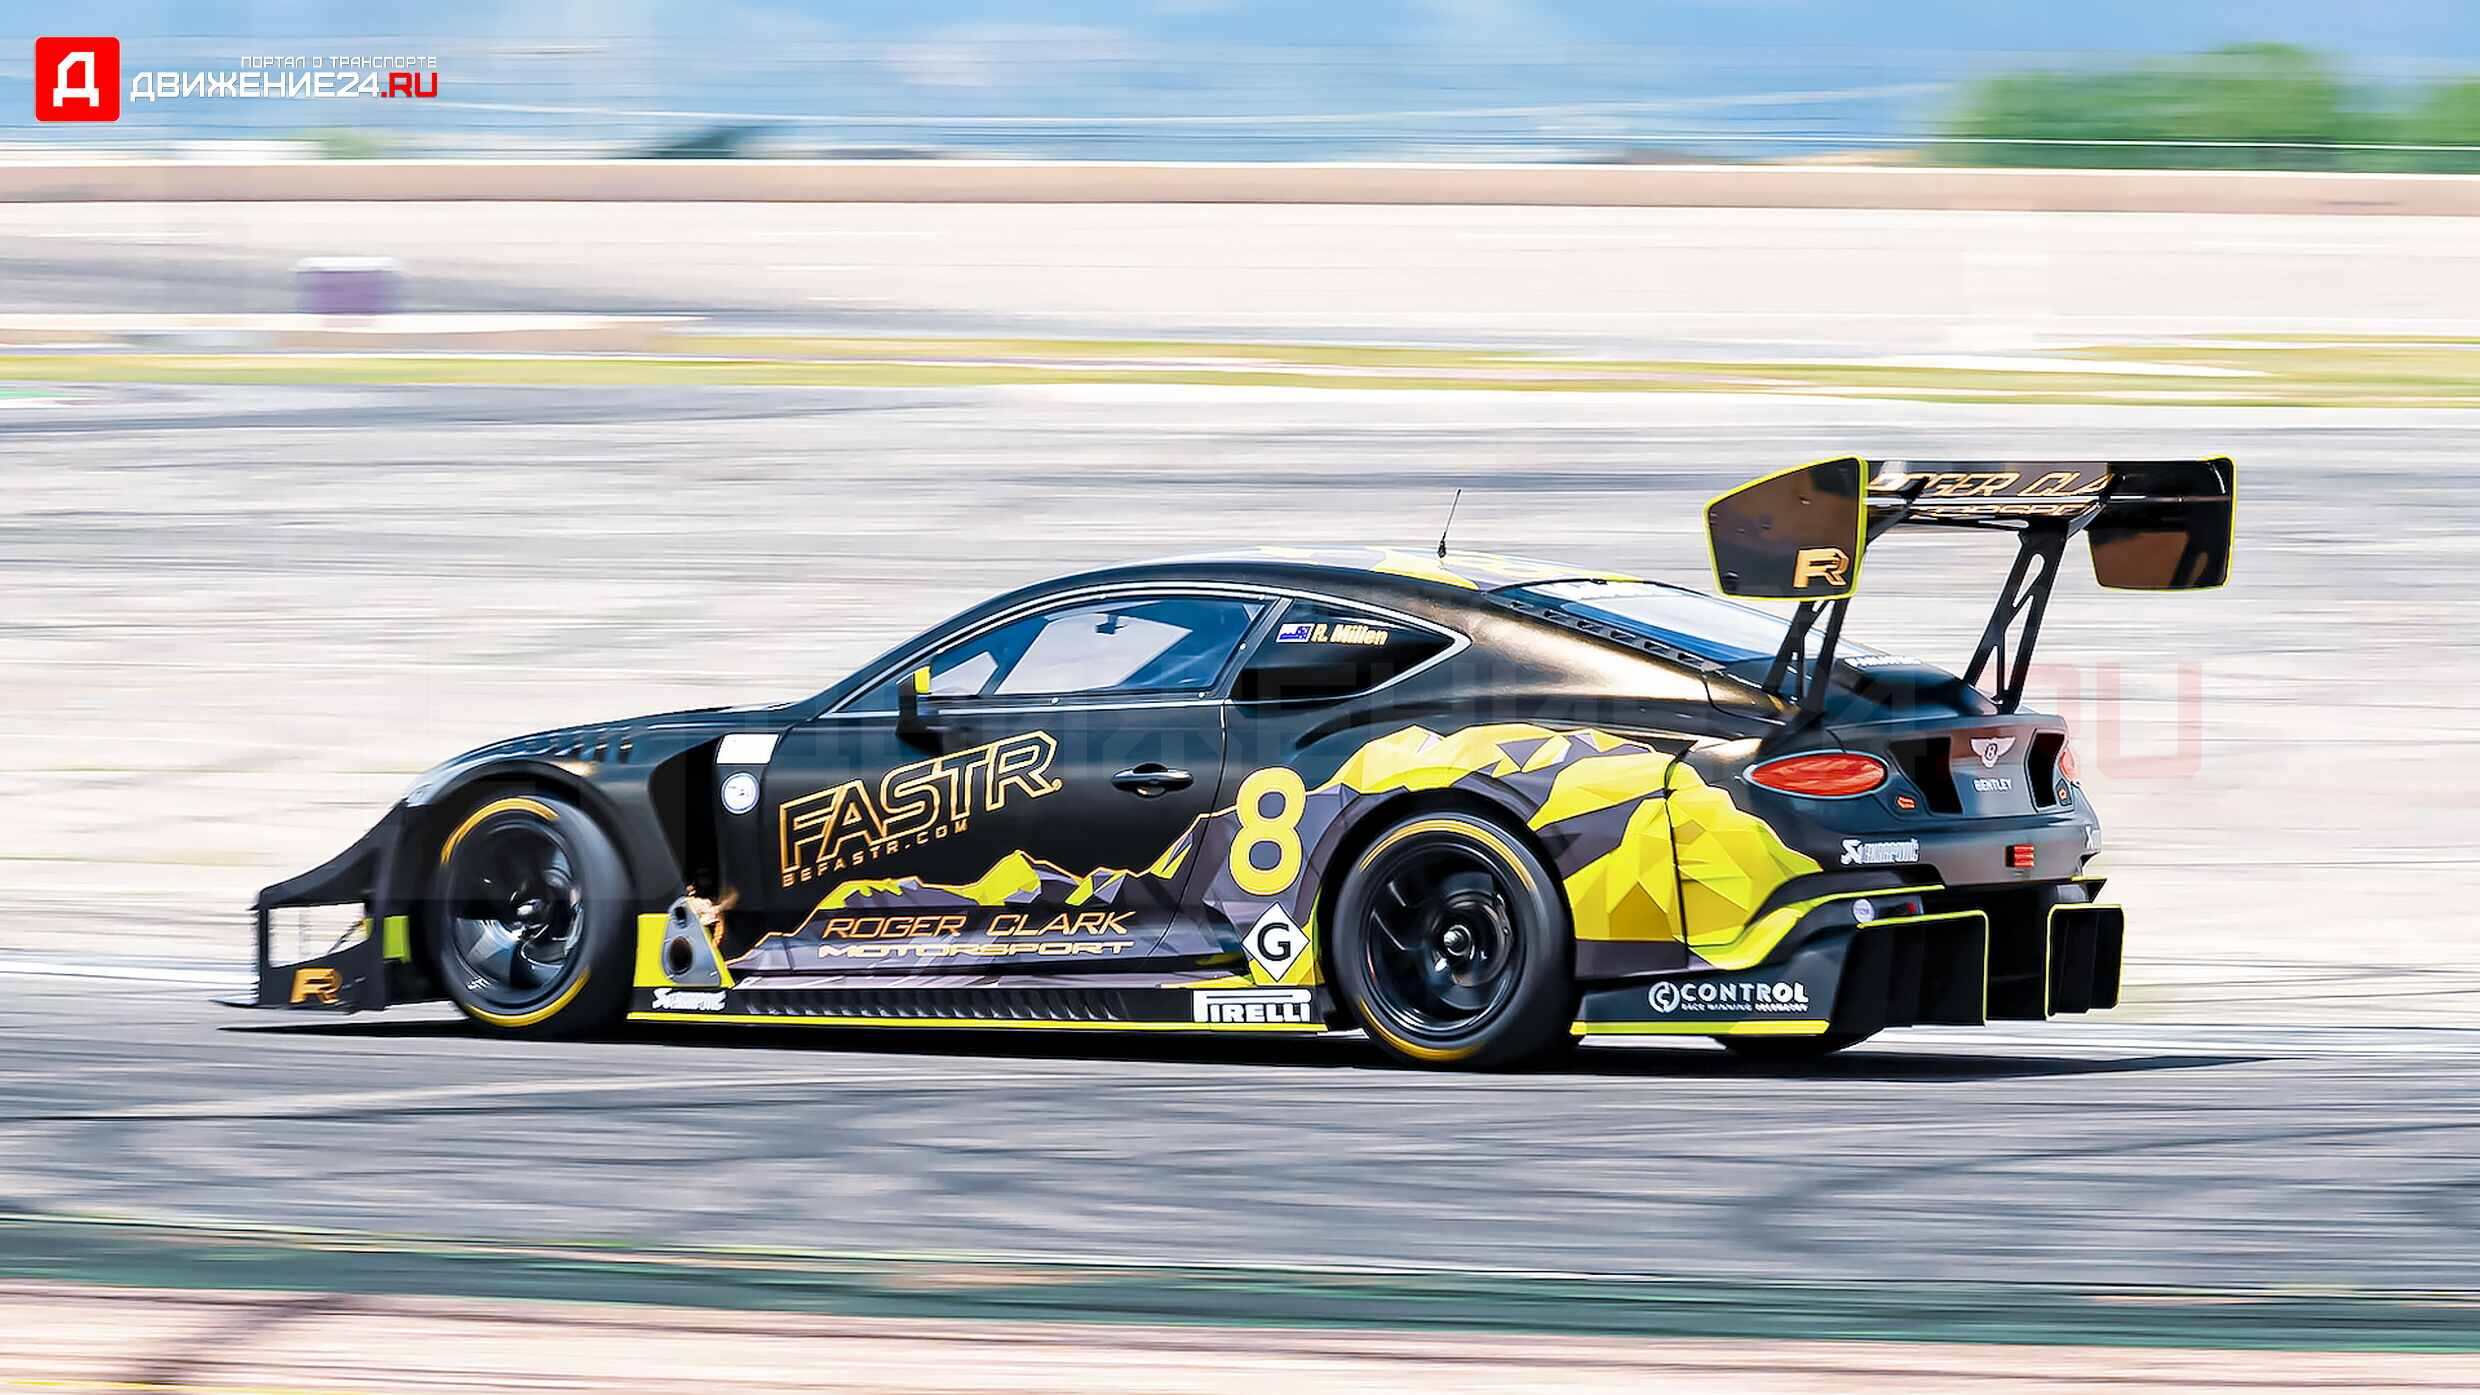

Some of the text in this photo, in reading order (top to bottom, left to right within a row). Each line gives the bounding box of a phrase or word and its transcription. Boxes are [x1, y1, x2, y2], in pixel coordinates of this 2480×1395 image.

[1311, 623, 1388, 646] R. Millen
[1973, 778, 2012, 791] BENTLEY
[1229, 766, 1307, 896] 8
[782, 819, 969, 888] BEFASTR.COM
[822, 911, 1137, 939] ROGER CLARK
[817, 940, 1136, 959] MOTORSPORT
[1257, 922, 1292, 962] G
[1193, 989, 1313, 1023] PIRELLI
[1680, 982, 1809, 1003] CONTROL
